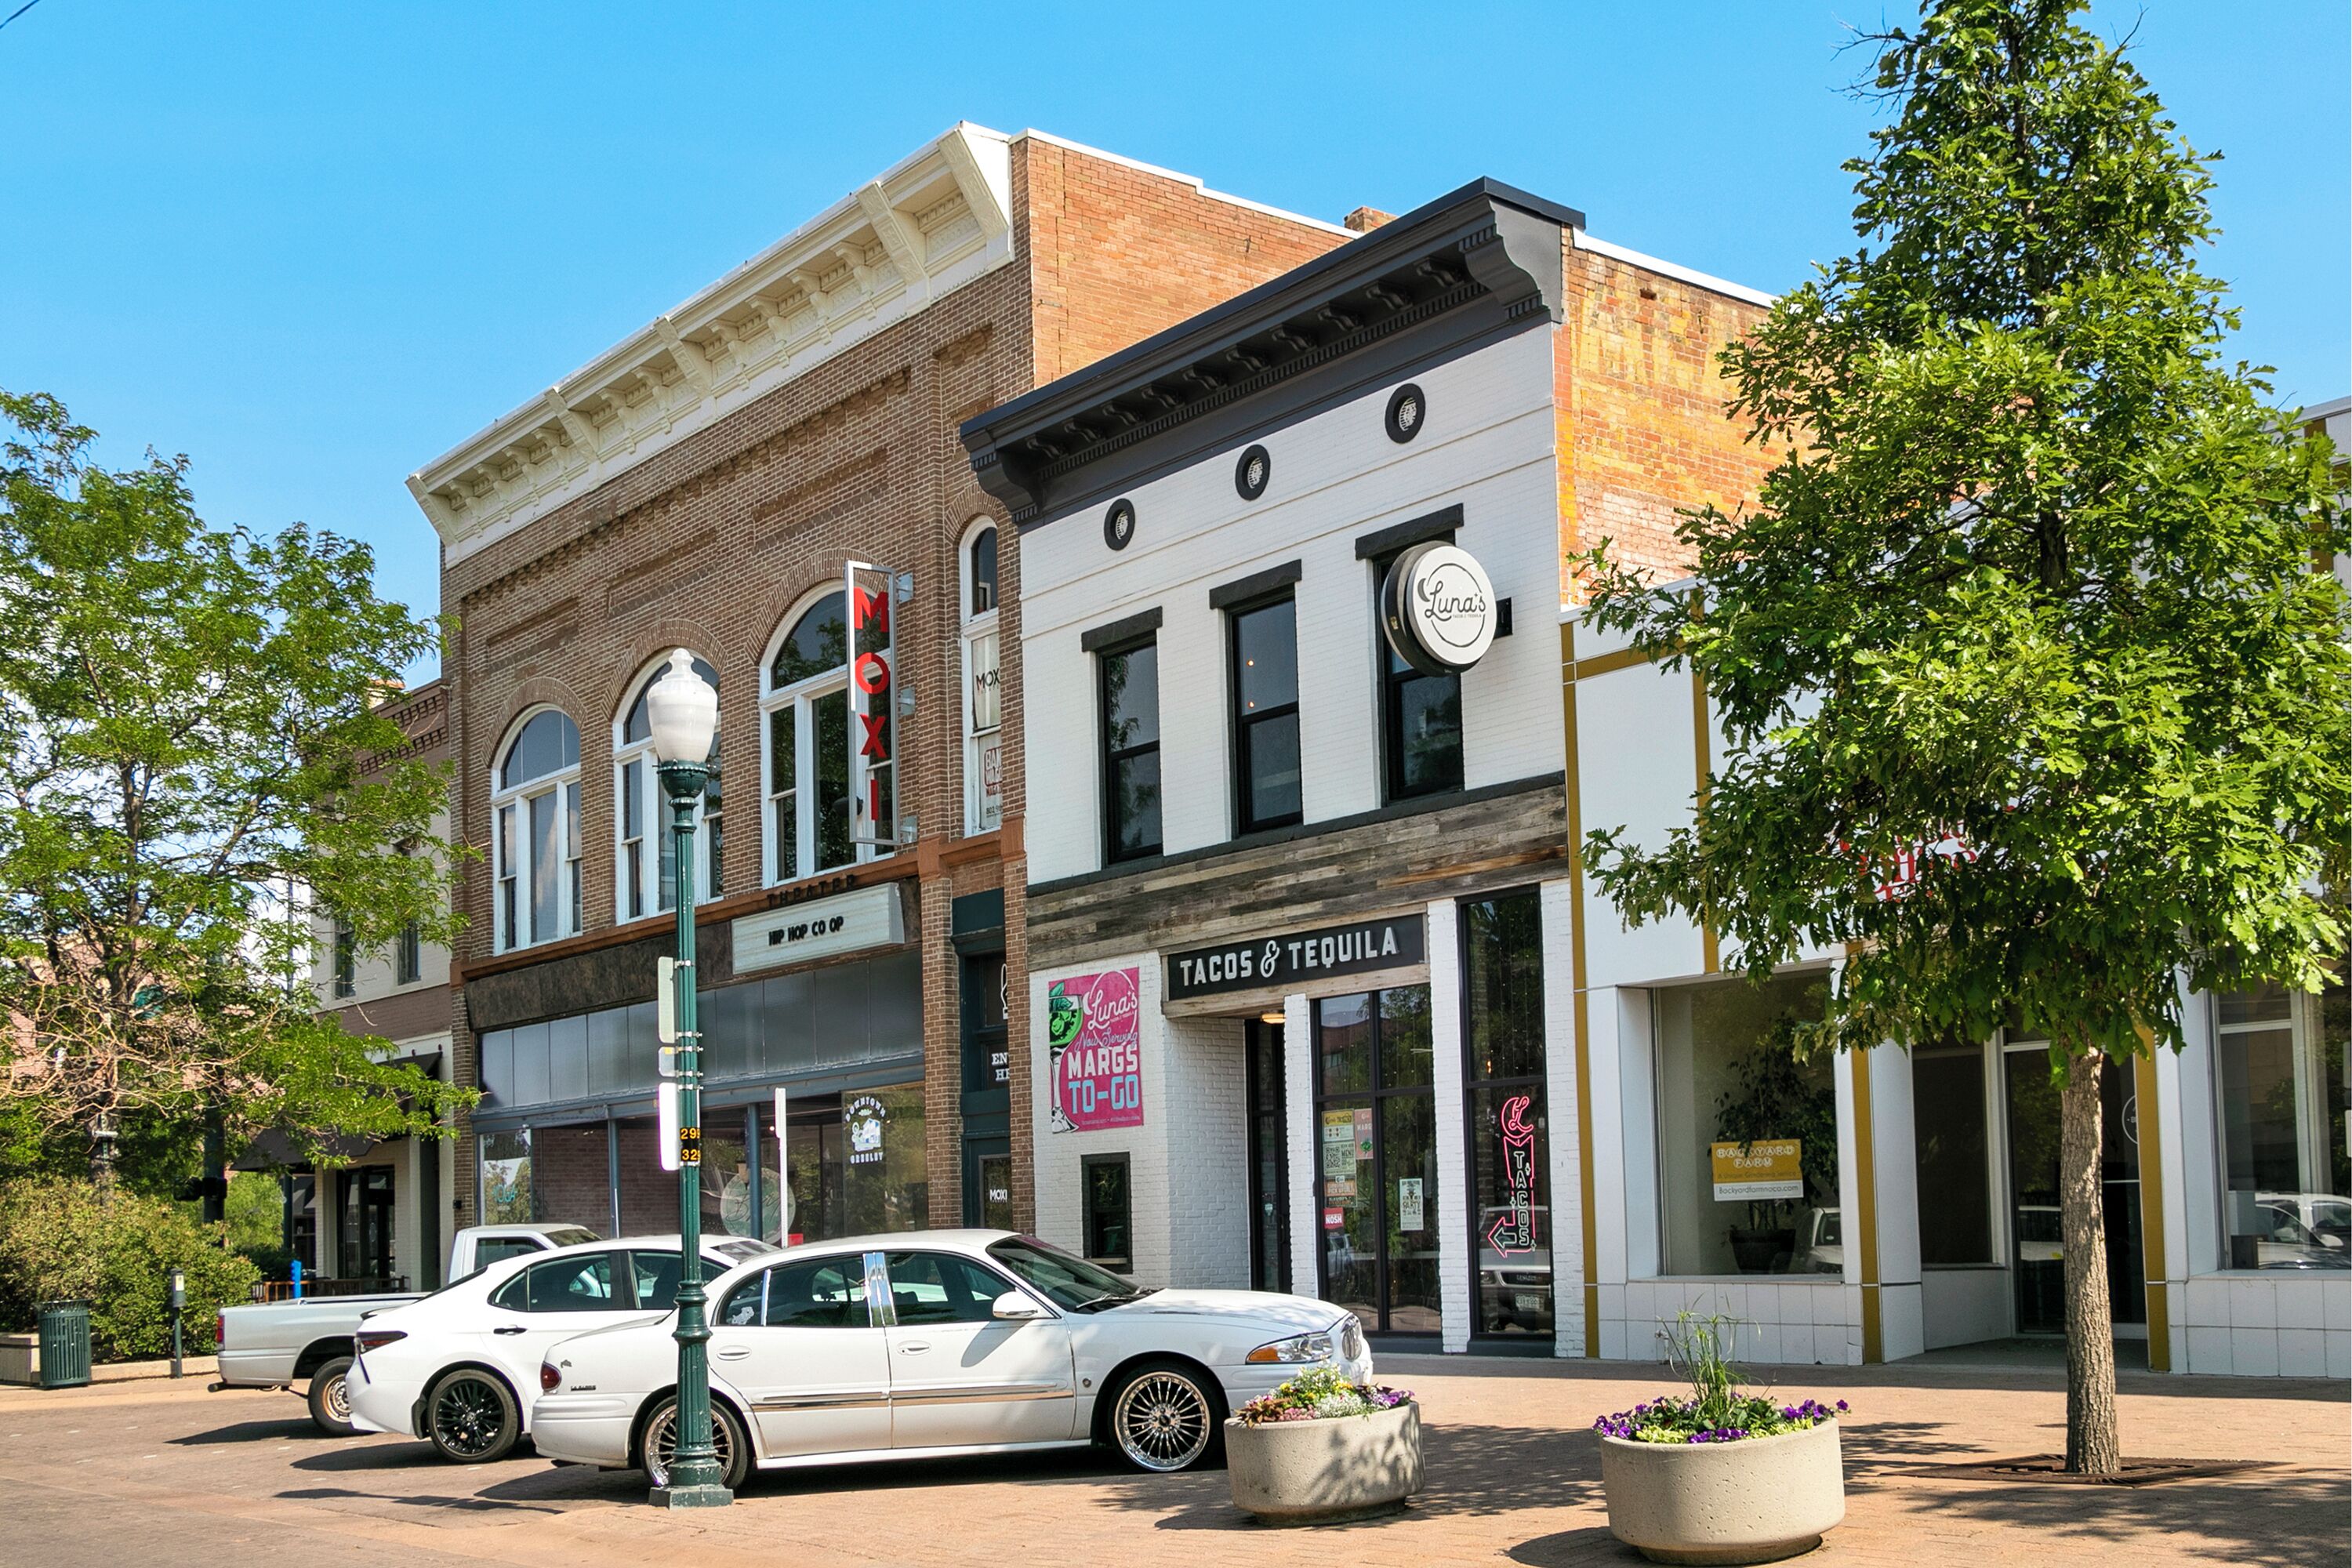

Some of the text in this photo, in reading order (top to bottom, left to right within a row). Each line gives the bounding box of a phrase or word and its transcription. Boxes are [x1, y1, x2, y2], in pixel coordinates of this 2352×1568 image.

[1425, 581, 1486, 622] Luna's
[854, 586, 890, 821] MOXI
[767, 874, 855, 906] THEATER
[769, 916, 844, 946] HIP HOP CO OP
[1180, 927, 1399, 986] TACOS & TEQUILA
[1087, 989, 1138, 1030] Luna's
[1075, 1027, 1138, 1052] Now Serving
[1067, 1044, 1138, 1079] MARGS
[845, 1096, 886, 1122] DOWNTOWN
[1068, 1075, 1138, 1114] TO-GO
[1733, 1156, 1773, 1168] FARM
[989, 1189, 1007, 1201] MOXI
[1513, 1151, 1530, 1246] TACOS
[1325, 1214, 1342, 1224] NOSH
